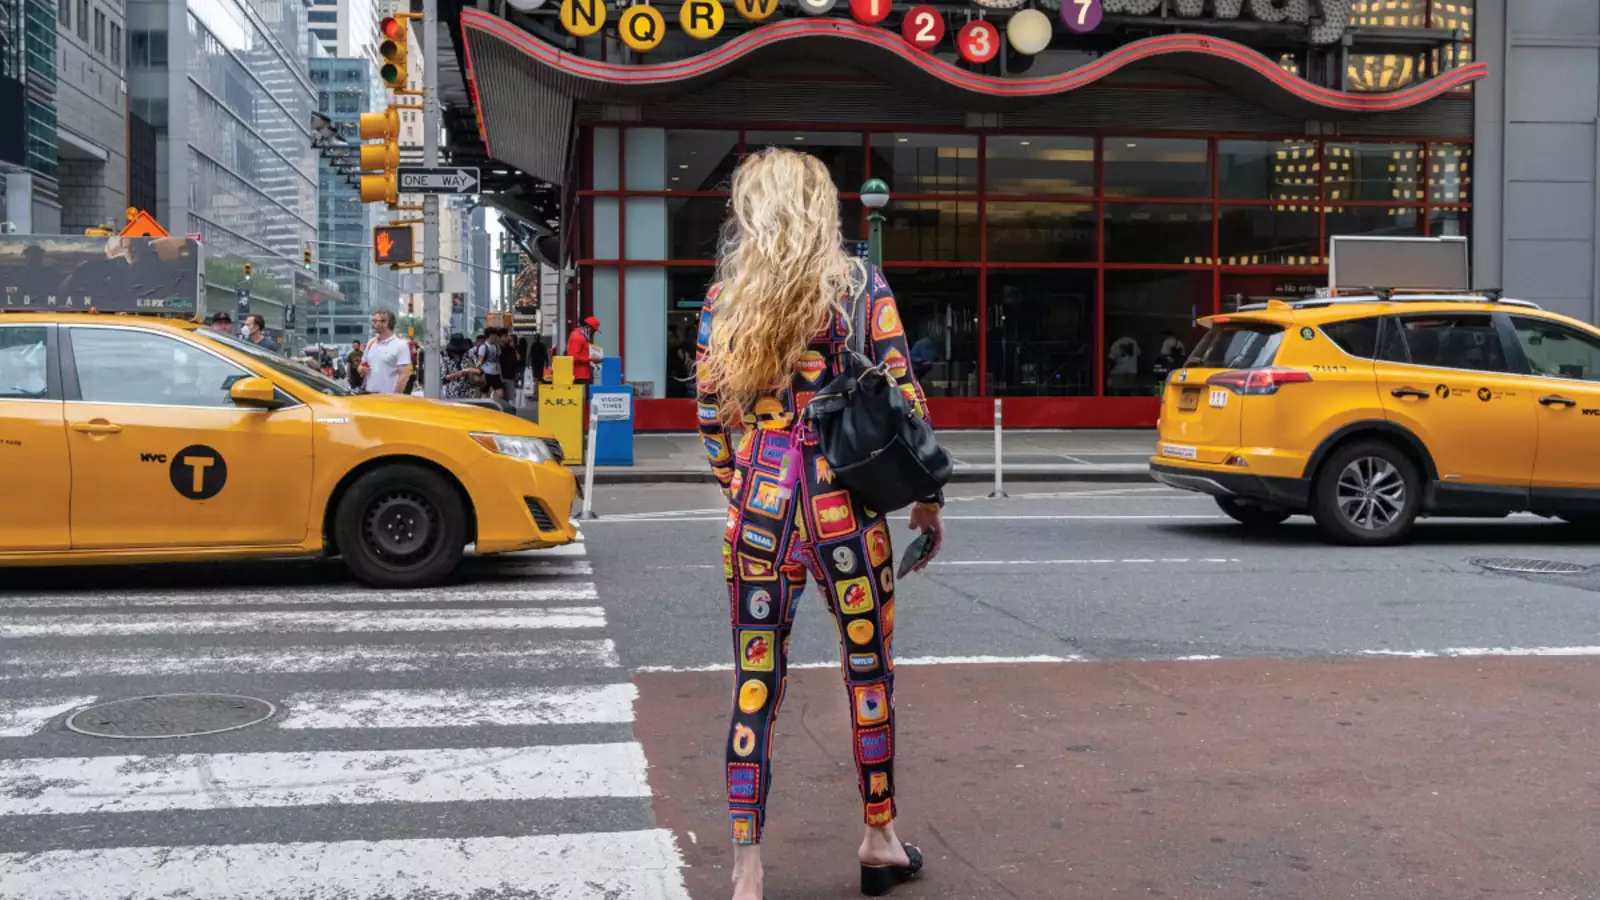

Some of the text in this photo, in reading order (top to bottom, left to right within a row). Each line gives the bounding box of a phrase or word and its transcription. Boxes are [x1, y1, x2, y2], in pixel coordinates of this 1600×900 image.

[571, 0, 596, 26] N
[690, 2, 715, 29] R
[1073, 0, 1092, 24] 7
[629, 12, 655, 42] Q
[915, 12, 936, 41] 2
[968, 26, 990, 56] 3
[404, 175, 467, 186] ONE WAY
[140, 453, 167, 463] NYC
[183, 455, 215, 493] T
